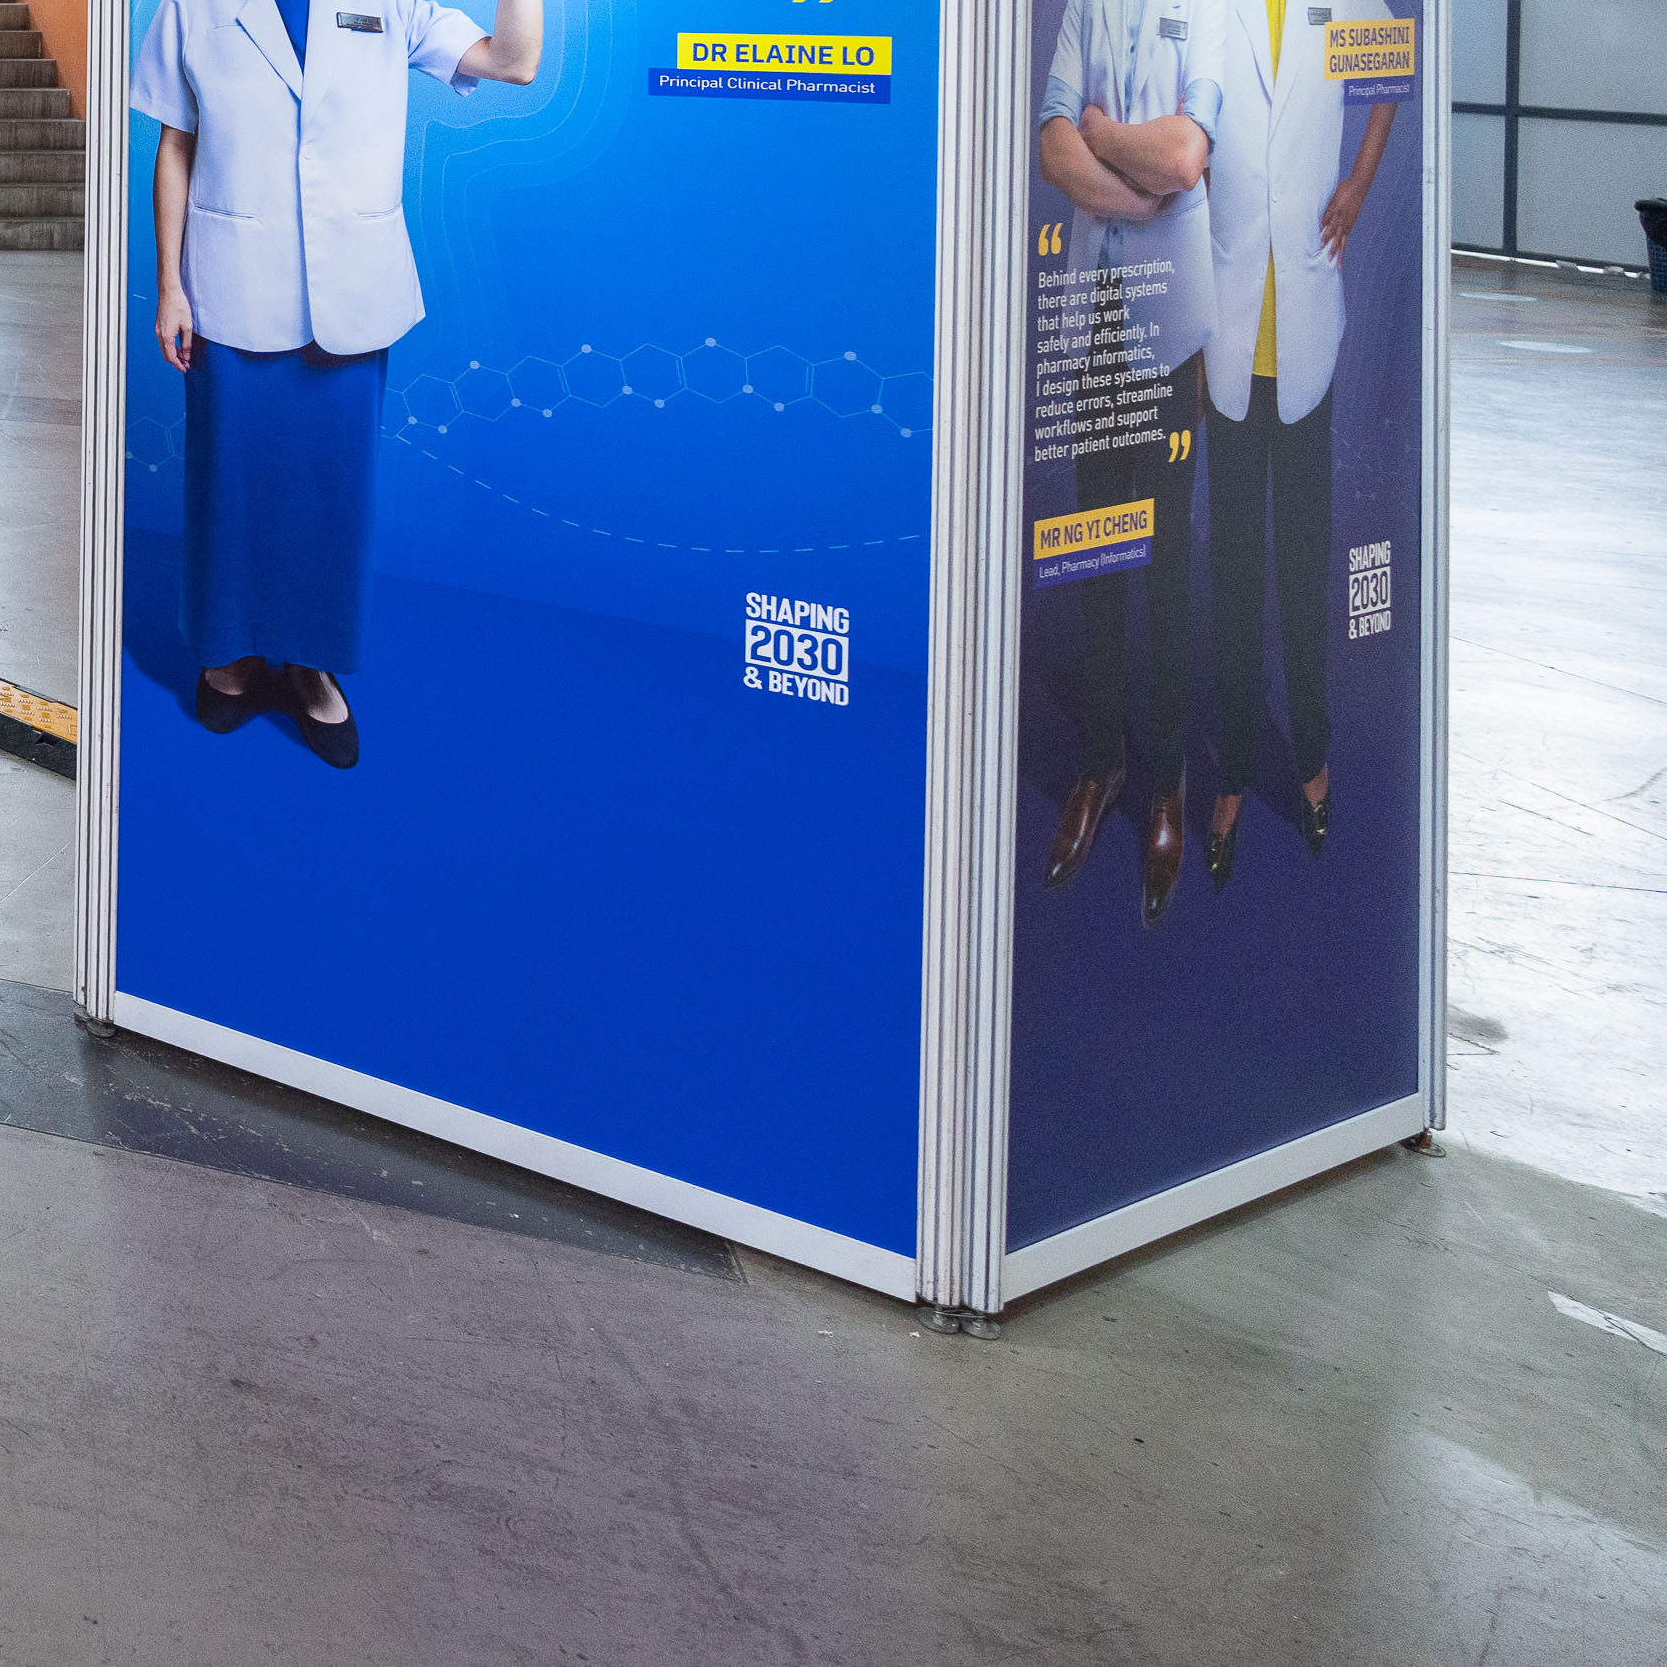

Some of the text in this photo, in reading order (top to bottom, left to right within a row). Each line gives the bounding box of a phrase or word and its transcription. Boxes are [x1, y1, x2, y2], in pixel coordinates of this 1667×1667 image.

[1330, 26, 1410, 48] MS SUBASHINI
[692, 43, 875, 66] DR ELAINE LO
[1329, 51, 1410, 73] GUNASEGARAN
[659, 75, 875, 94] Principal Clinical Pharmacist
[1040, 510, 1148, 550] MR NG YI CHENG
[1349, 540, 1391, 572] SHAPING
[1352, 571, 1388, 612] 2030
[745, 592, 850, 634] SHAPING
[1349, 611, 1391, 639] & BEYOND
[749, 623, 846, 676] 2030
[743, 666, 849, 706] & BEYOND
